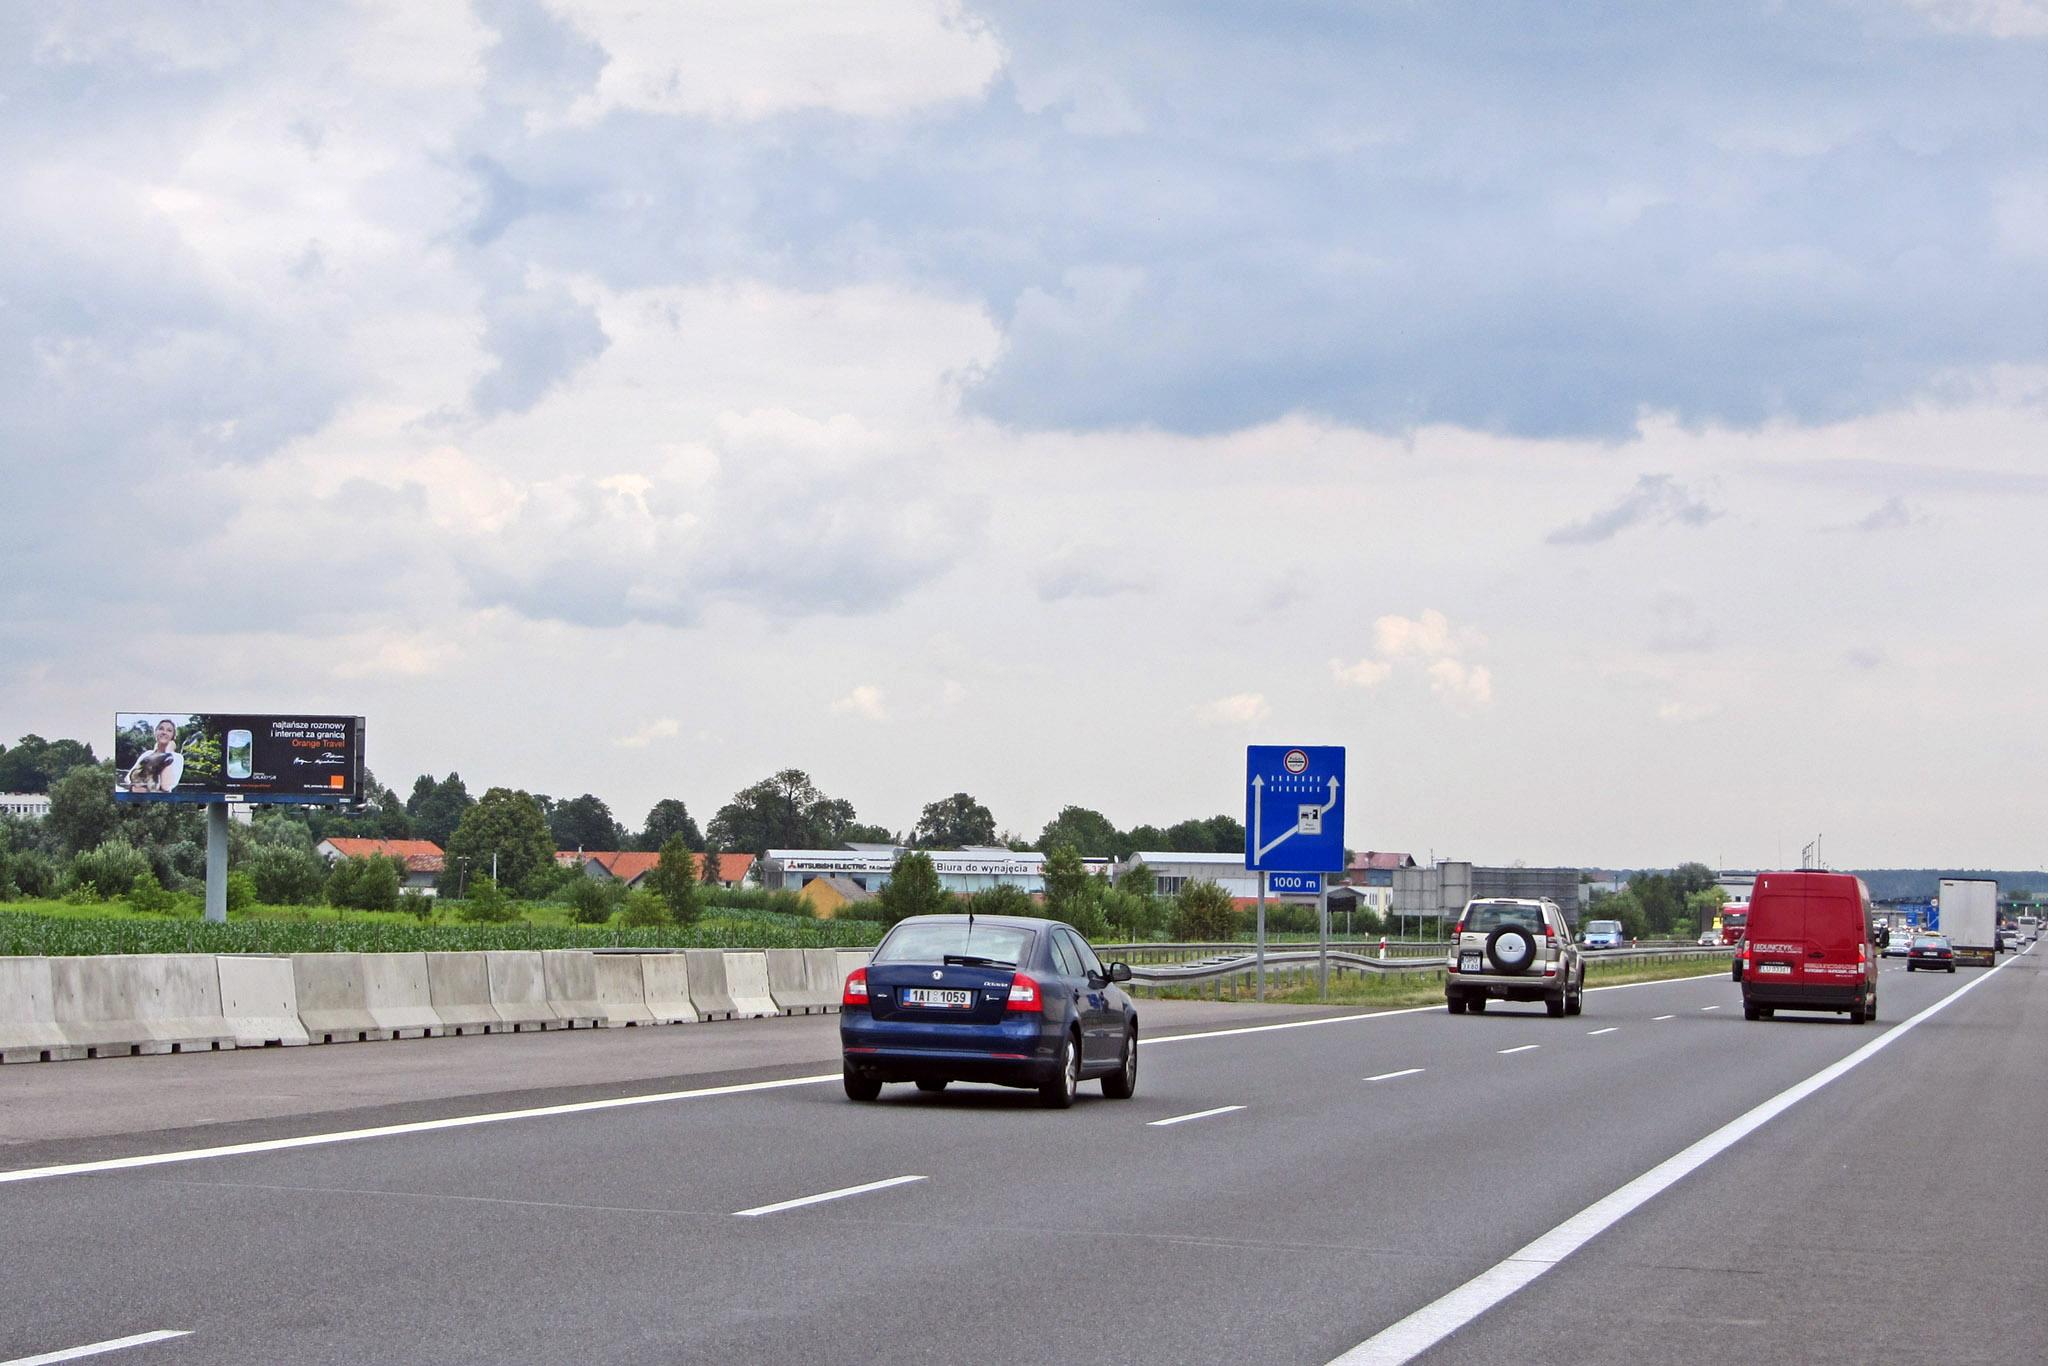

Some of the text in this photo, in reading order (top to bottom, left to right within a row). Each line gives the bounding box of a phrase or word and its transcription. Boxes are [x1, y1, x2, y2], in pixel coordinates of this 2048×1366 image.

[273, 721, 345, 730] najtańsze rozmowy
[316, 731, 345, 740] granicą
[292, 739, 345, 748] Orange Travel
[936, 863, 962, 872] Biura
[965, 863, 978, 872] do
[981, 864, 1028, 875] wynajęcia
[1273, 877, 1316, 888] 1000 m
[912, 990, 967, 1004] 1AI 1059
